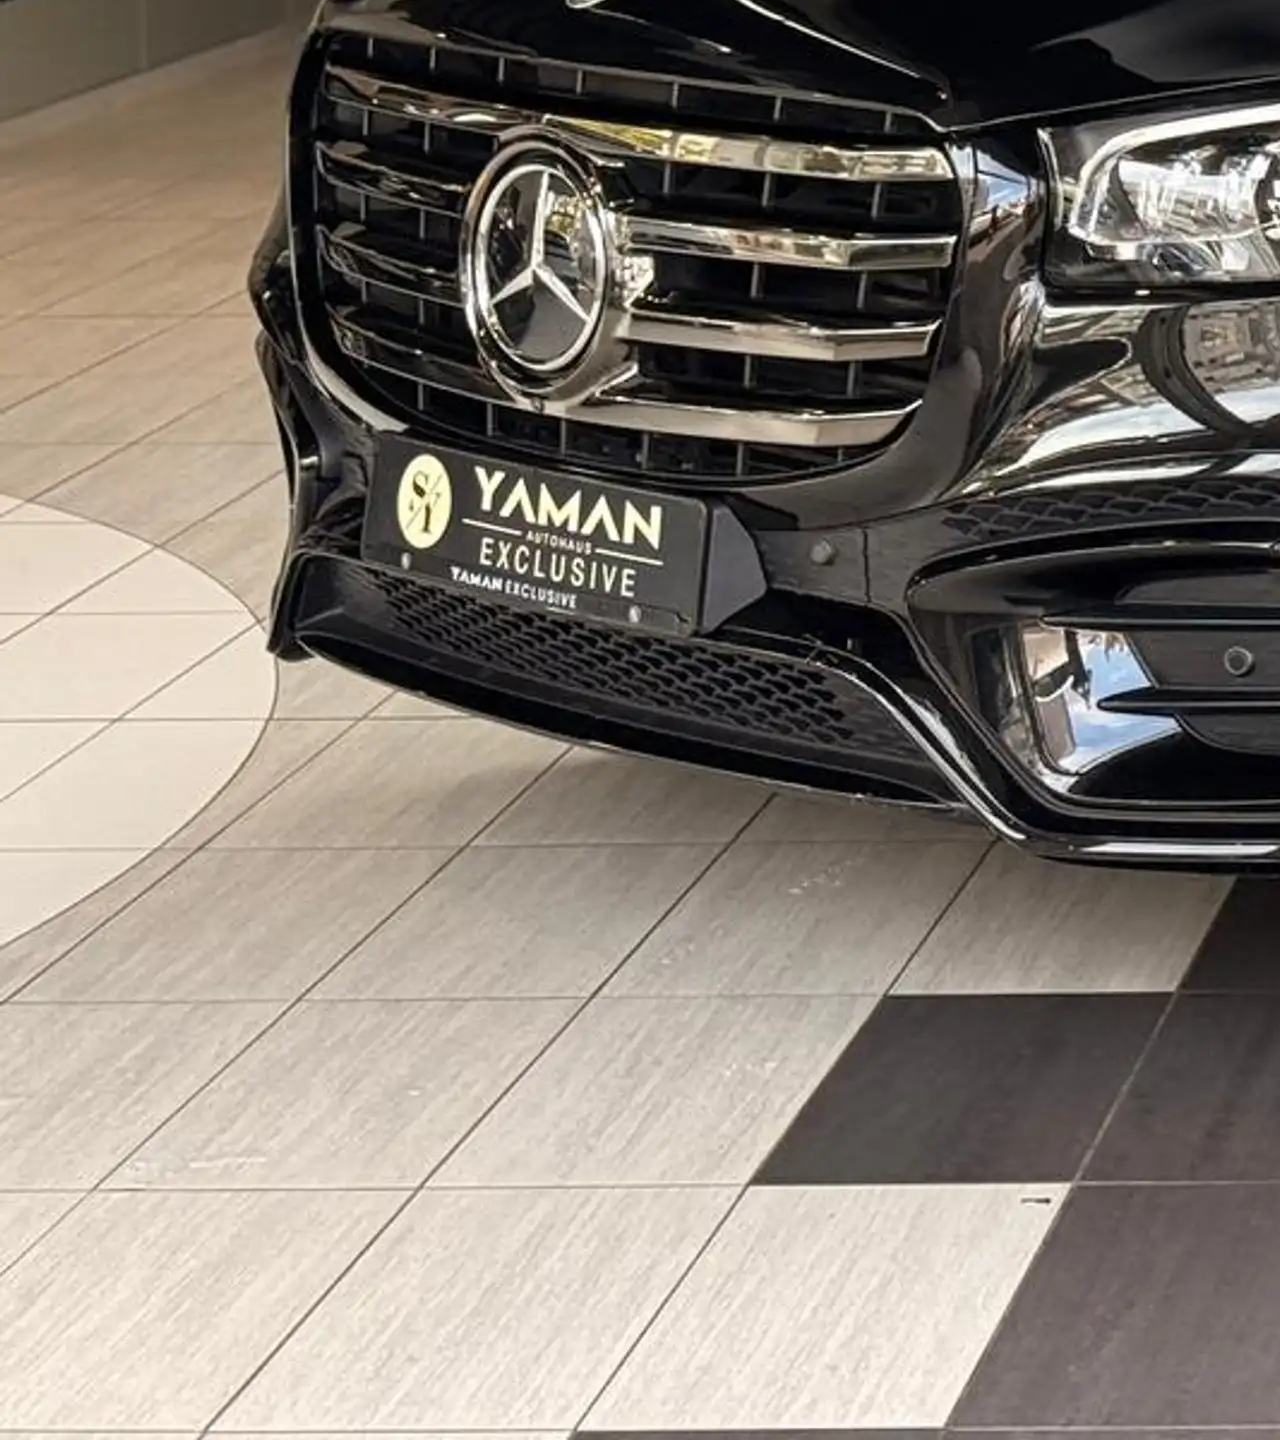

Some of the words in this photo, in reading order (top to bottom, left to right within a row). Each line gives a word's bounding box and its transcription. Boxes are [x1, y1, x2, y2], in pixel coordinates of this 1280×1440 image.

[475, 465, 663, 551] YAMAN
[479, 536, 637, 598] EXCLUSIVE
[525, 529, 592, 556] AUTOHAUS
[450, 565, 503, 593] YAMAN
[504, 578, 577, 609] EXCLUSIVE
